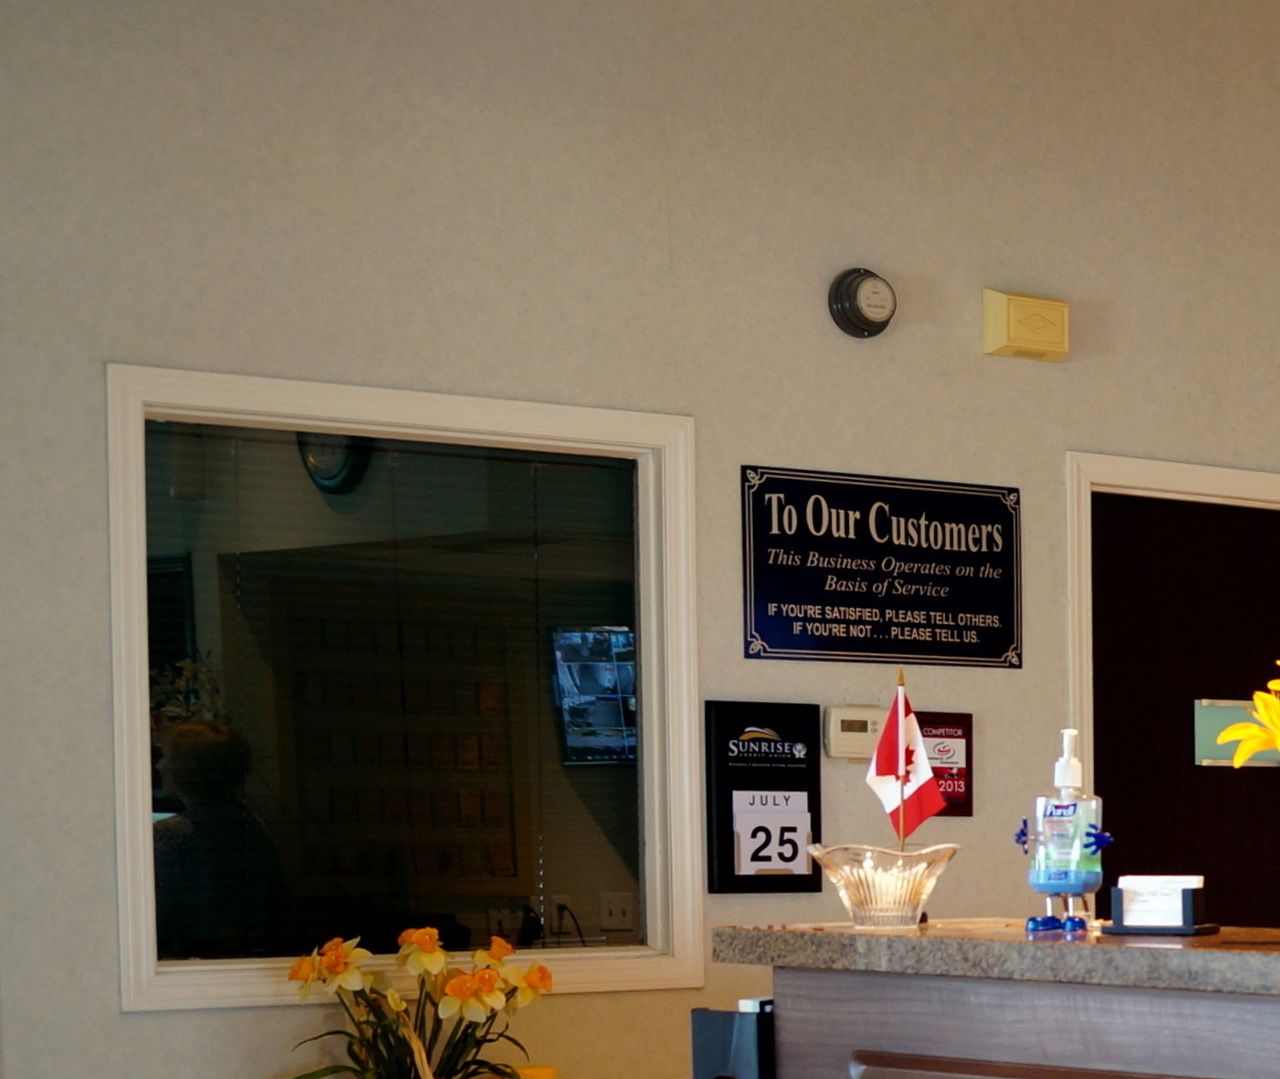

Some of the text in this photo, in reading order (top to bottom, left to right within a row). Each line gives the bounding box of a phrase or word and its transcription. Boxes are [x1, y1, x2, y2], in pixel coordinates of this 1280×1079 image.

[765, 494, 1003, 552] To Our Customers
[768, 549, 1002, 578] This Business Operates on the
[825, 575, 949, 597] Basis of Service
[768, 603, 1001, 627] IF YOU'RE SATISFIED, PLEASE TELL OTHERS.
[794, 622, 803, 634] IF
[806, 623, 846, 636] YOU'RE
[891, 627, 932, 640] PLEASE
[935, 629, 960, 642] TELL
[963, 631, 979, 642] US.
[938, 781, 964, 793] 2013
[749, 795, 790, 806] JULY
[751, 826, 798, 862] 25
